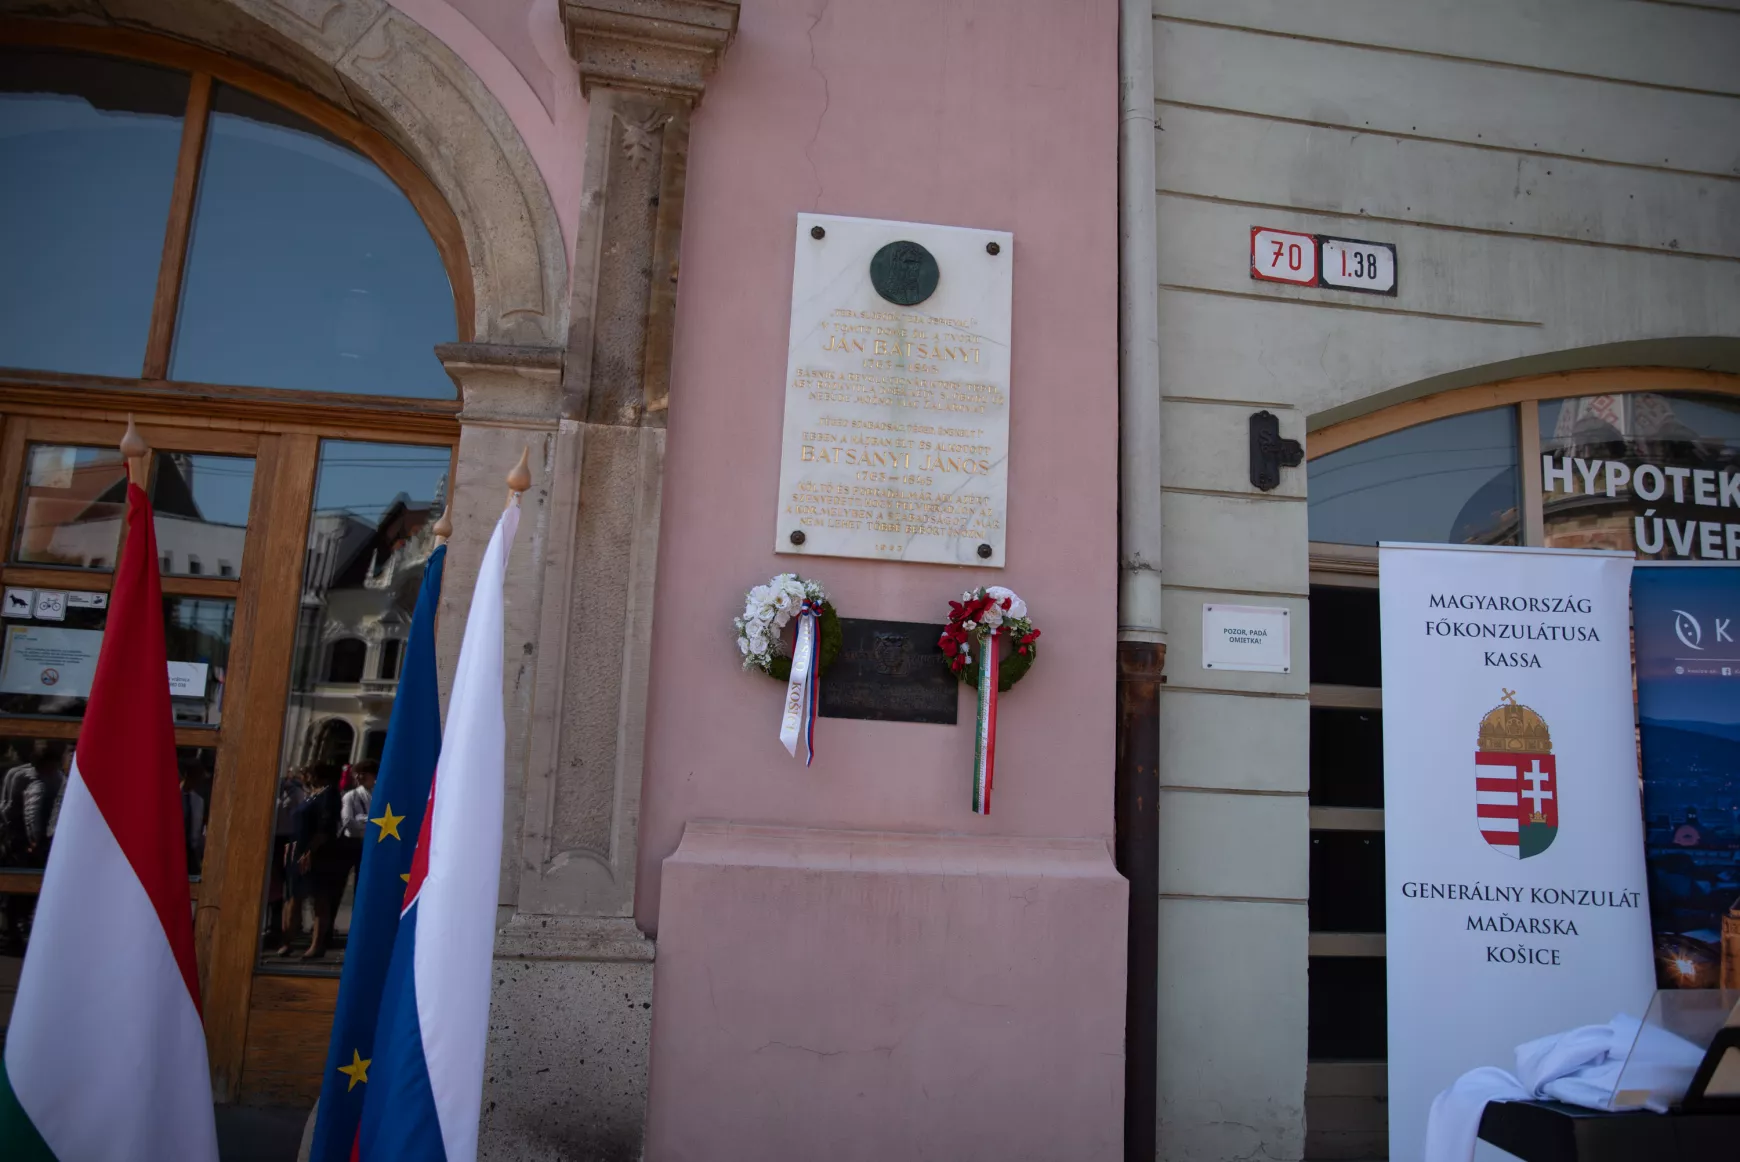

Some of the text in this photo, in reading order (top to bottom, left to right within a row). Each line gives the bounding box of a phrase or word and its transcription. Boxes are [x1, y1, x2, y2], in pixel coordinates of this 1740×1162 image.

[1270, 240, 1303, 271] 70
[823, 334, 866, 354] JÁN
[801, 444, 990, 475] BATSÁNYI JÁNOS
[856, 471, 886, 482] 1763
[903, 475, 933, 485] 1845
[1542, 455, 1740, 508] HYPOTEK
[1429, 593, 1592, 614] MAGYARORSZÁG
[1223, 628, 1267, 636] POZOR, PADÁ
[1229, 636, 1262, 644] OMIETKA!
[1425, 618, 1600, 642] FŐKONZULÁTUSA
[1484, 651, 1543, 668] KASSA
[1402, 881, 1641, 909] GENERÁLNY KONZULÁT
[1466, 912, 1579, 936] MAĎARSKA
[1485, 943, 1561, 966] KOŠICE
